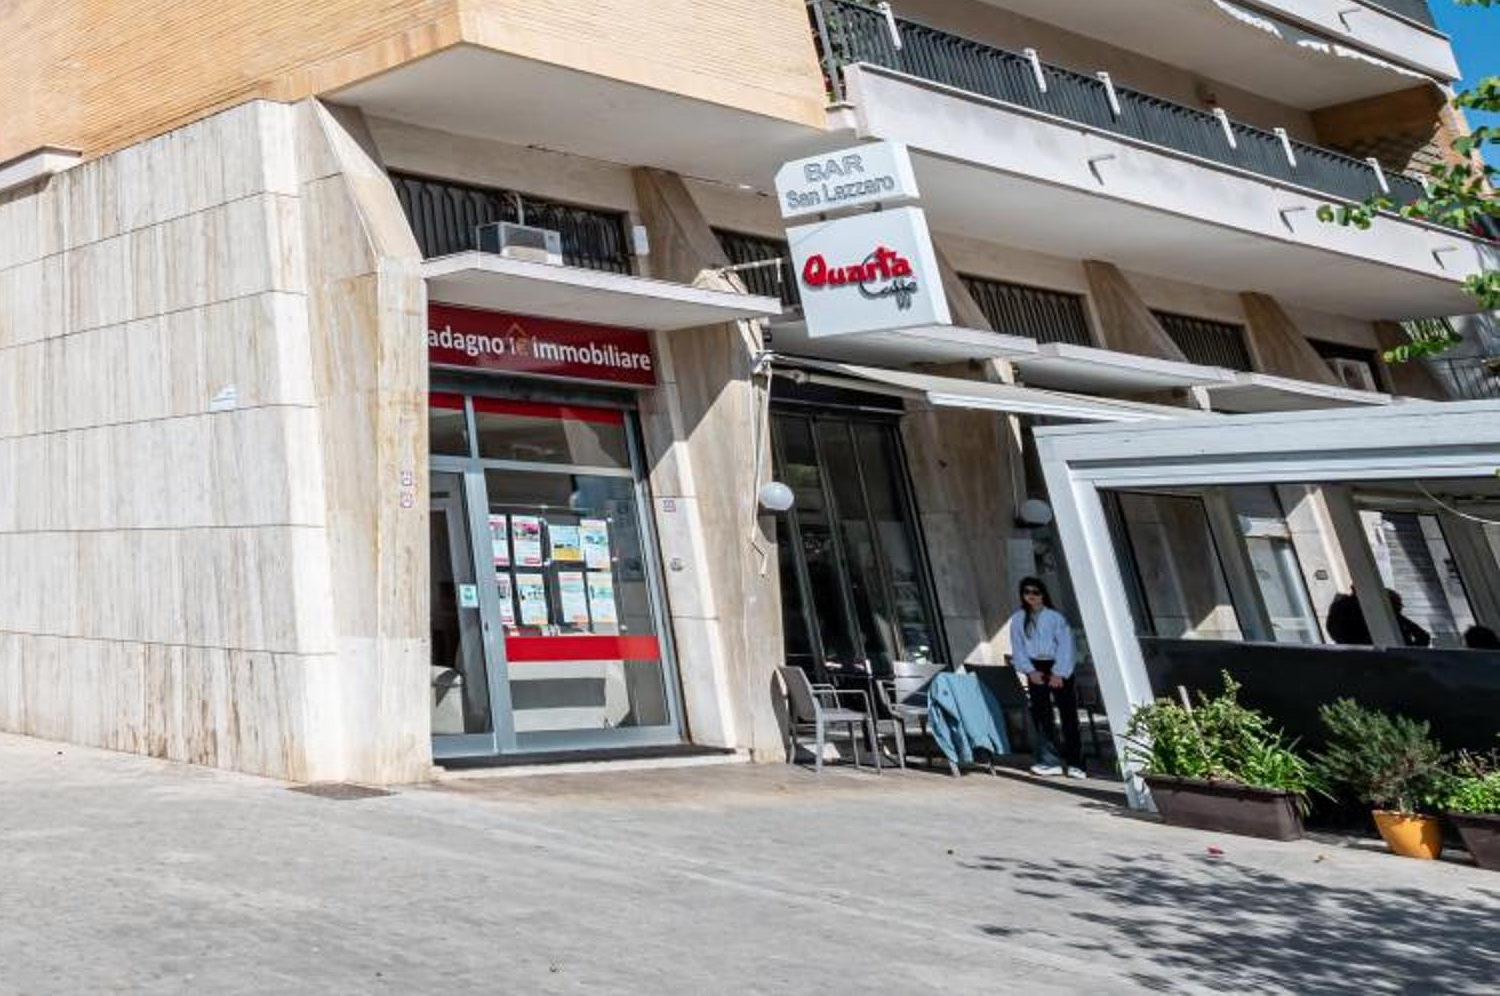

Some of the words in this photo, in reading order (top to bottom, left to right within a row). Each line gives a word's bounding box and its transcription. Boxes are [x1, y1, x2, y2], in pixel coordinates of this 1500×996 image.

[804, 153, 865, 183] BAR
[786, 190, 821, 209] San
[822, 175, 895, 202] Lazzaro
[803, 246, 913, 286] Quarta
[532, 335, 652, 372] immobiliare
